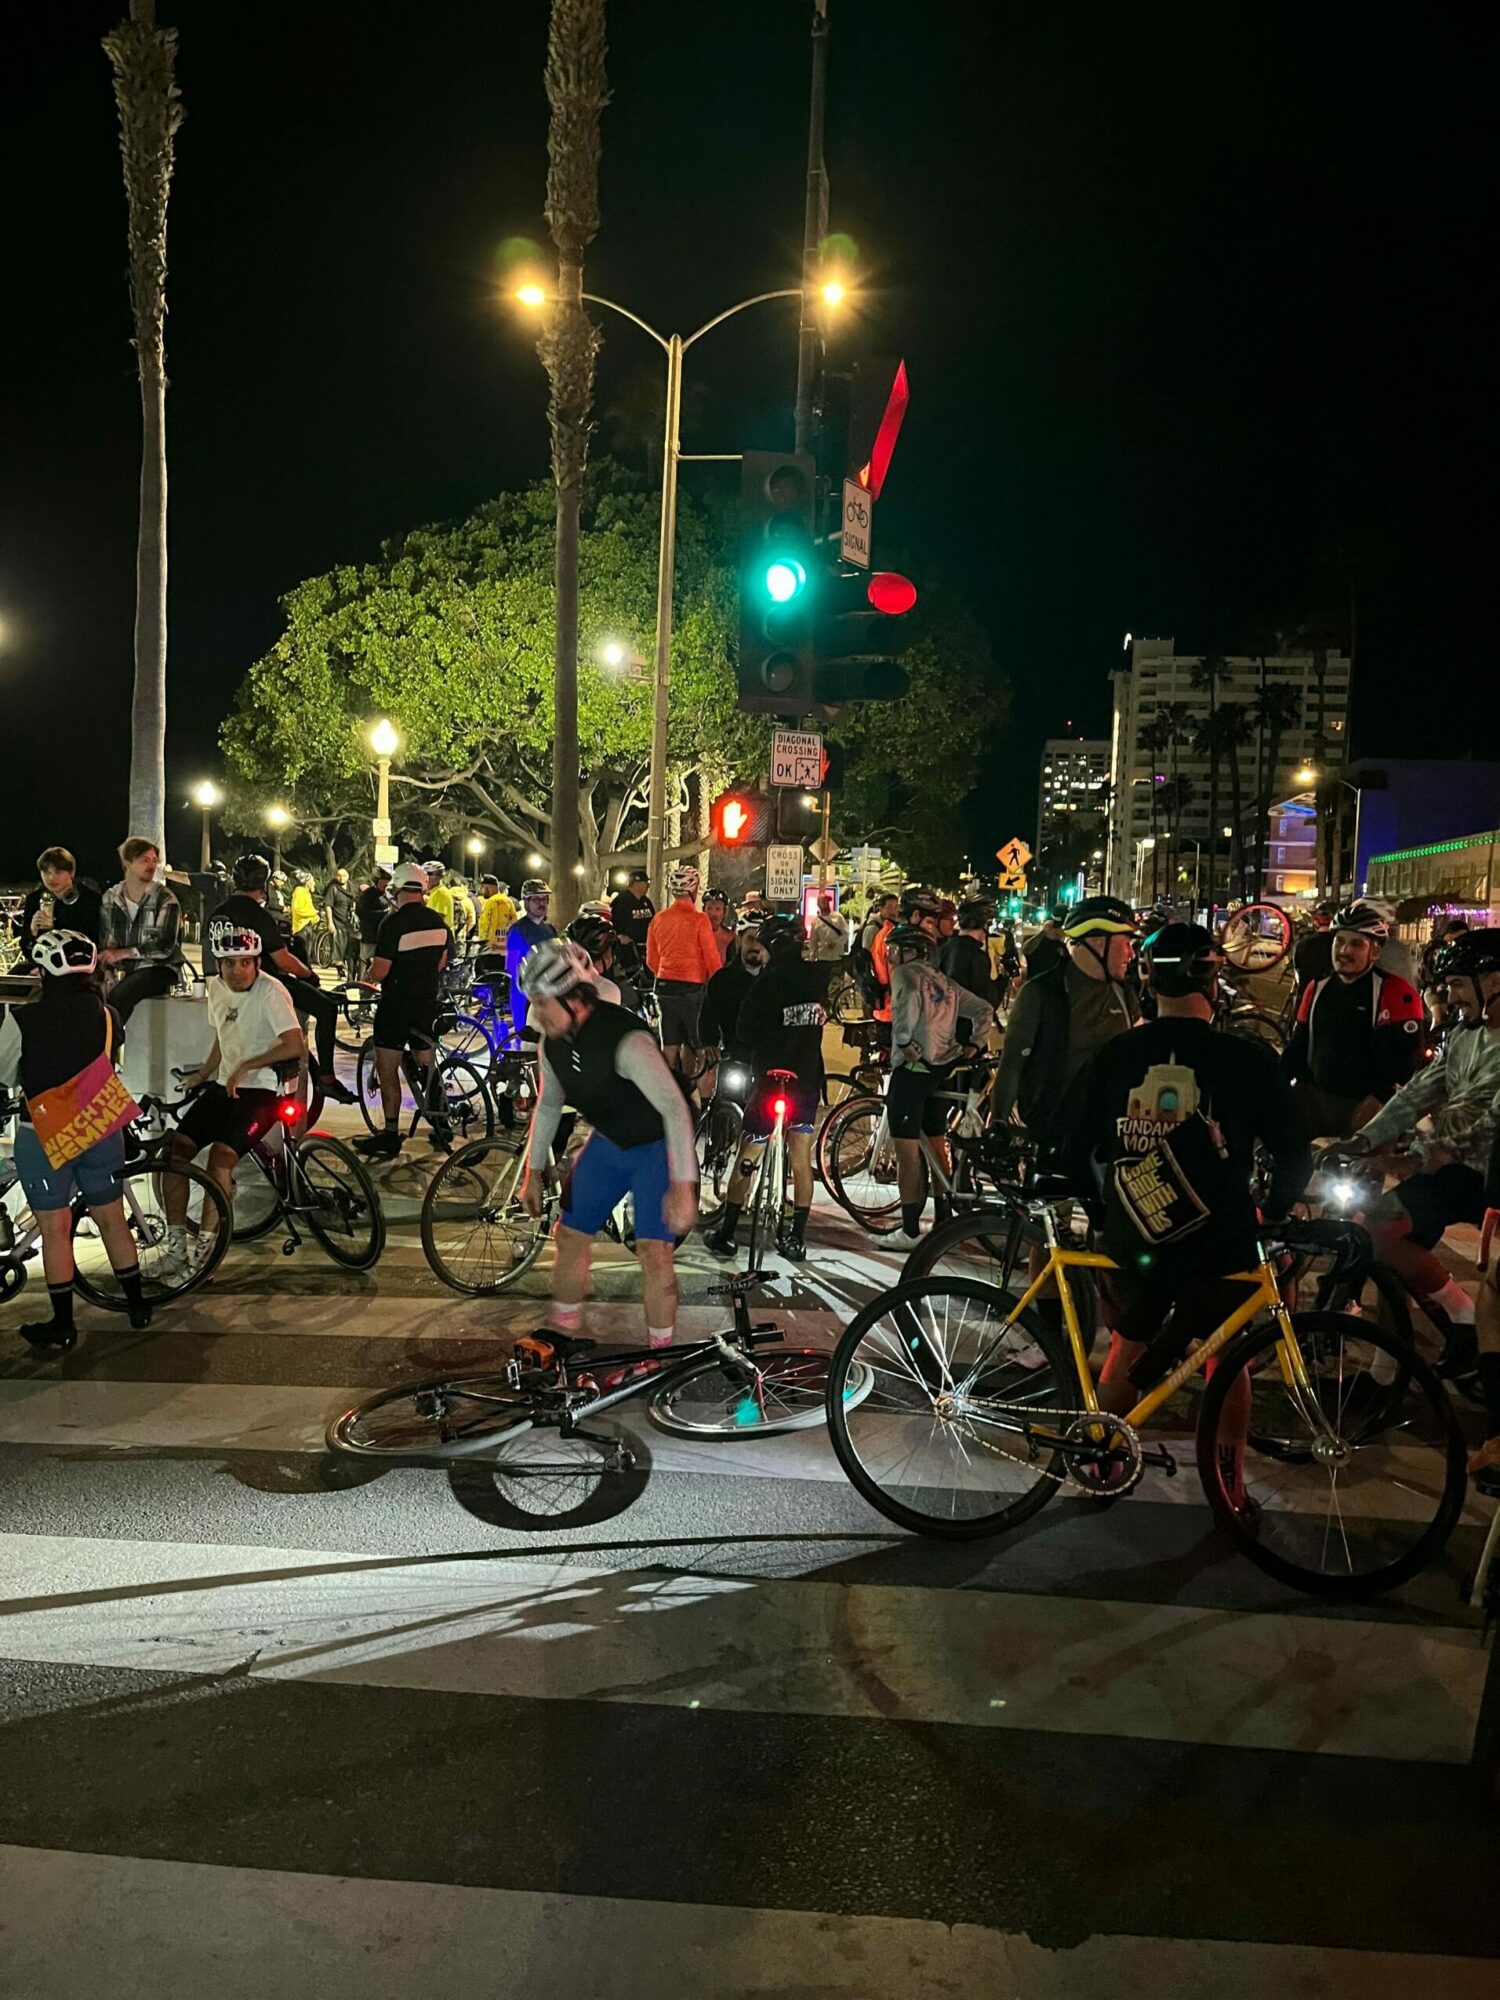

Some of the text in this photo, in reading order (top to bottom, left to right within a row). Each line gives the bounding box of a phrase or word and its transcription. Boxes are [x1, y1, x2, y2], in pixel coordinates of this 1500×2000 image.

[844, 532, 867, 555] SIGNAL
[777, 734, 817, 746] DIAGONAL
[776, 744, 818, 757] CROSSING
[776, 763, 792, 777] OK
[771, 851, 798, 860] CROSS
[770, 877, 798, 886] SIGNAL
[774, 868, 794, 877] WALK
[773, 886, 795, 895] ONLY
[44, 1073, 122, 1155] WATCH THE
[48, 1085, 132, 1171] FEMMES
[1116, 1117, 1181, 1137] FUNDAM
[1120, 1150, 1164, 1182] COME
[1128, 1169, 1165, 1200] RIDE
[1135, 1182, 1179, 1216] WITH
[1146, 1210, 1174, 1234] US
